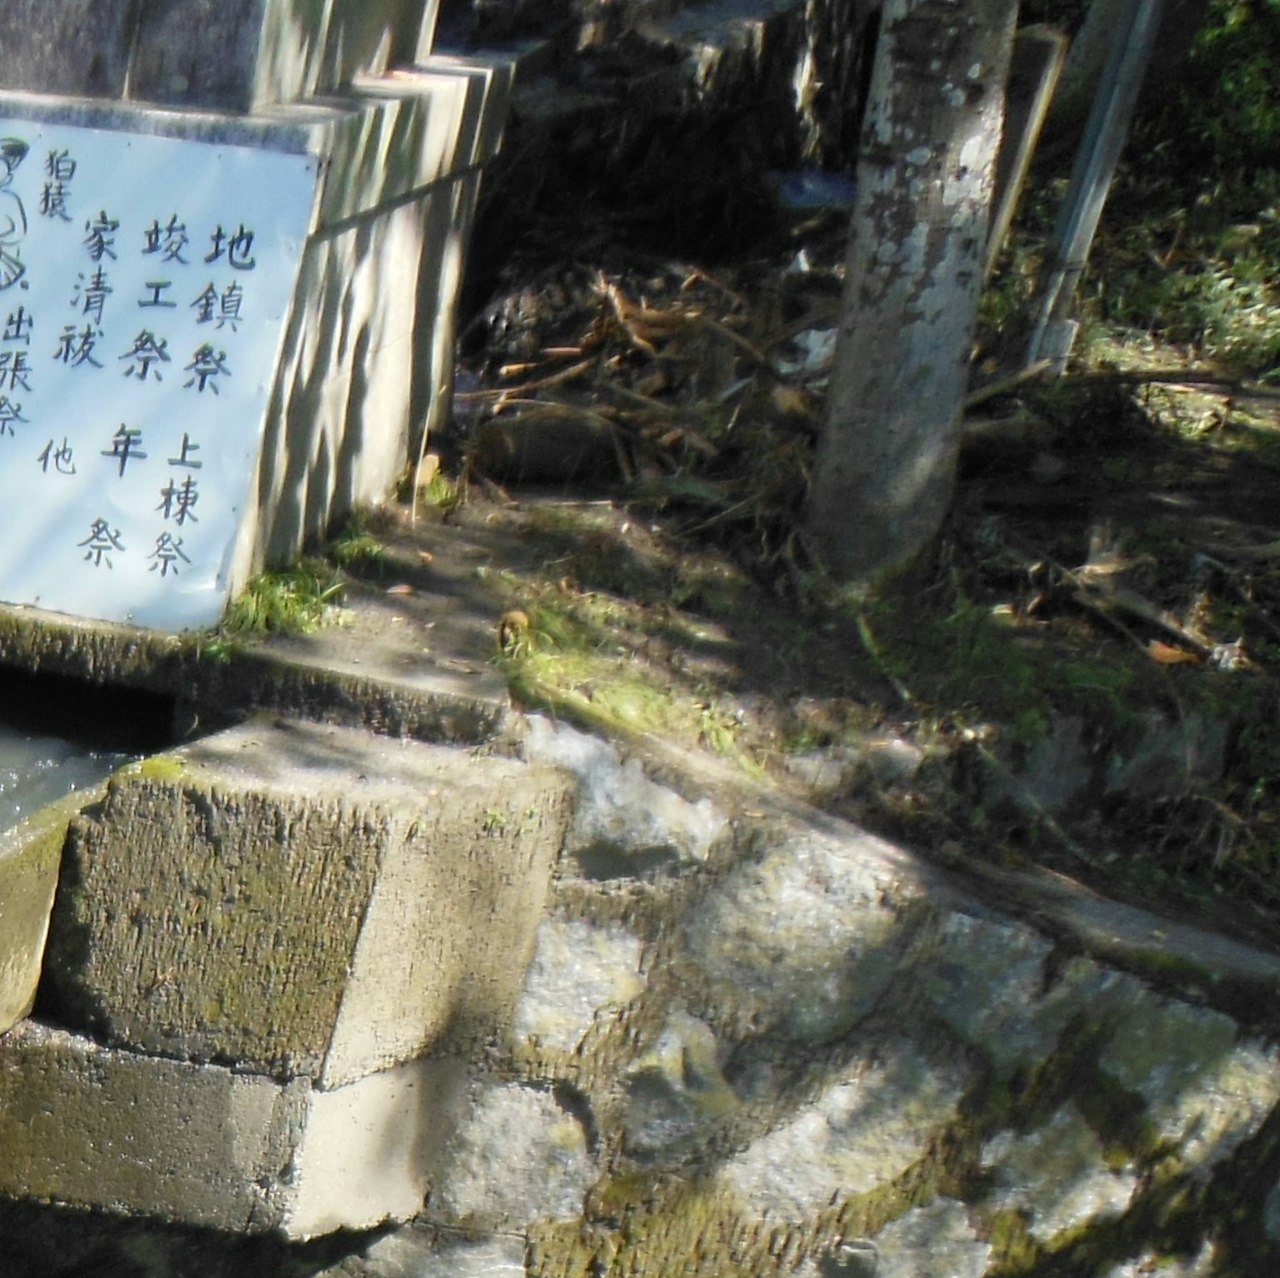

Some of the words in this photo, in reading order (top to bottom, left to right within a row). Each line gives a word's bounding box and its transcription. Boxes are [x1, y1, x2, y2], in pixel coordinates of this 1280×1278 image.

[52, 210, 120, 370] 家清祓
[118, 213, 191, 383] 竣工祭
[184, 222, 256, 396] 地鎮祭
[37, 437, 76, 476] 他
[77, 422, 148, 569] 年祭
[147, 431, 204, 577] 上棟祭
